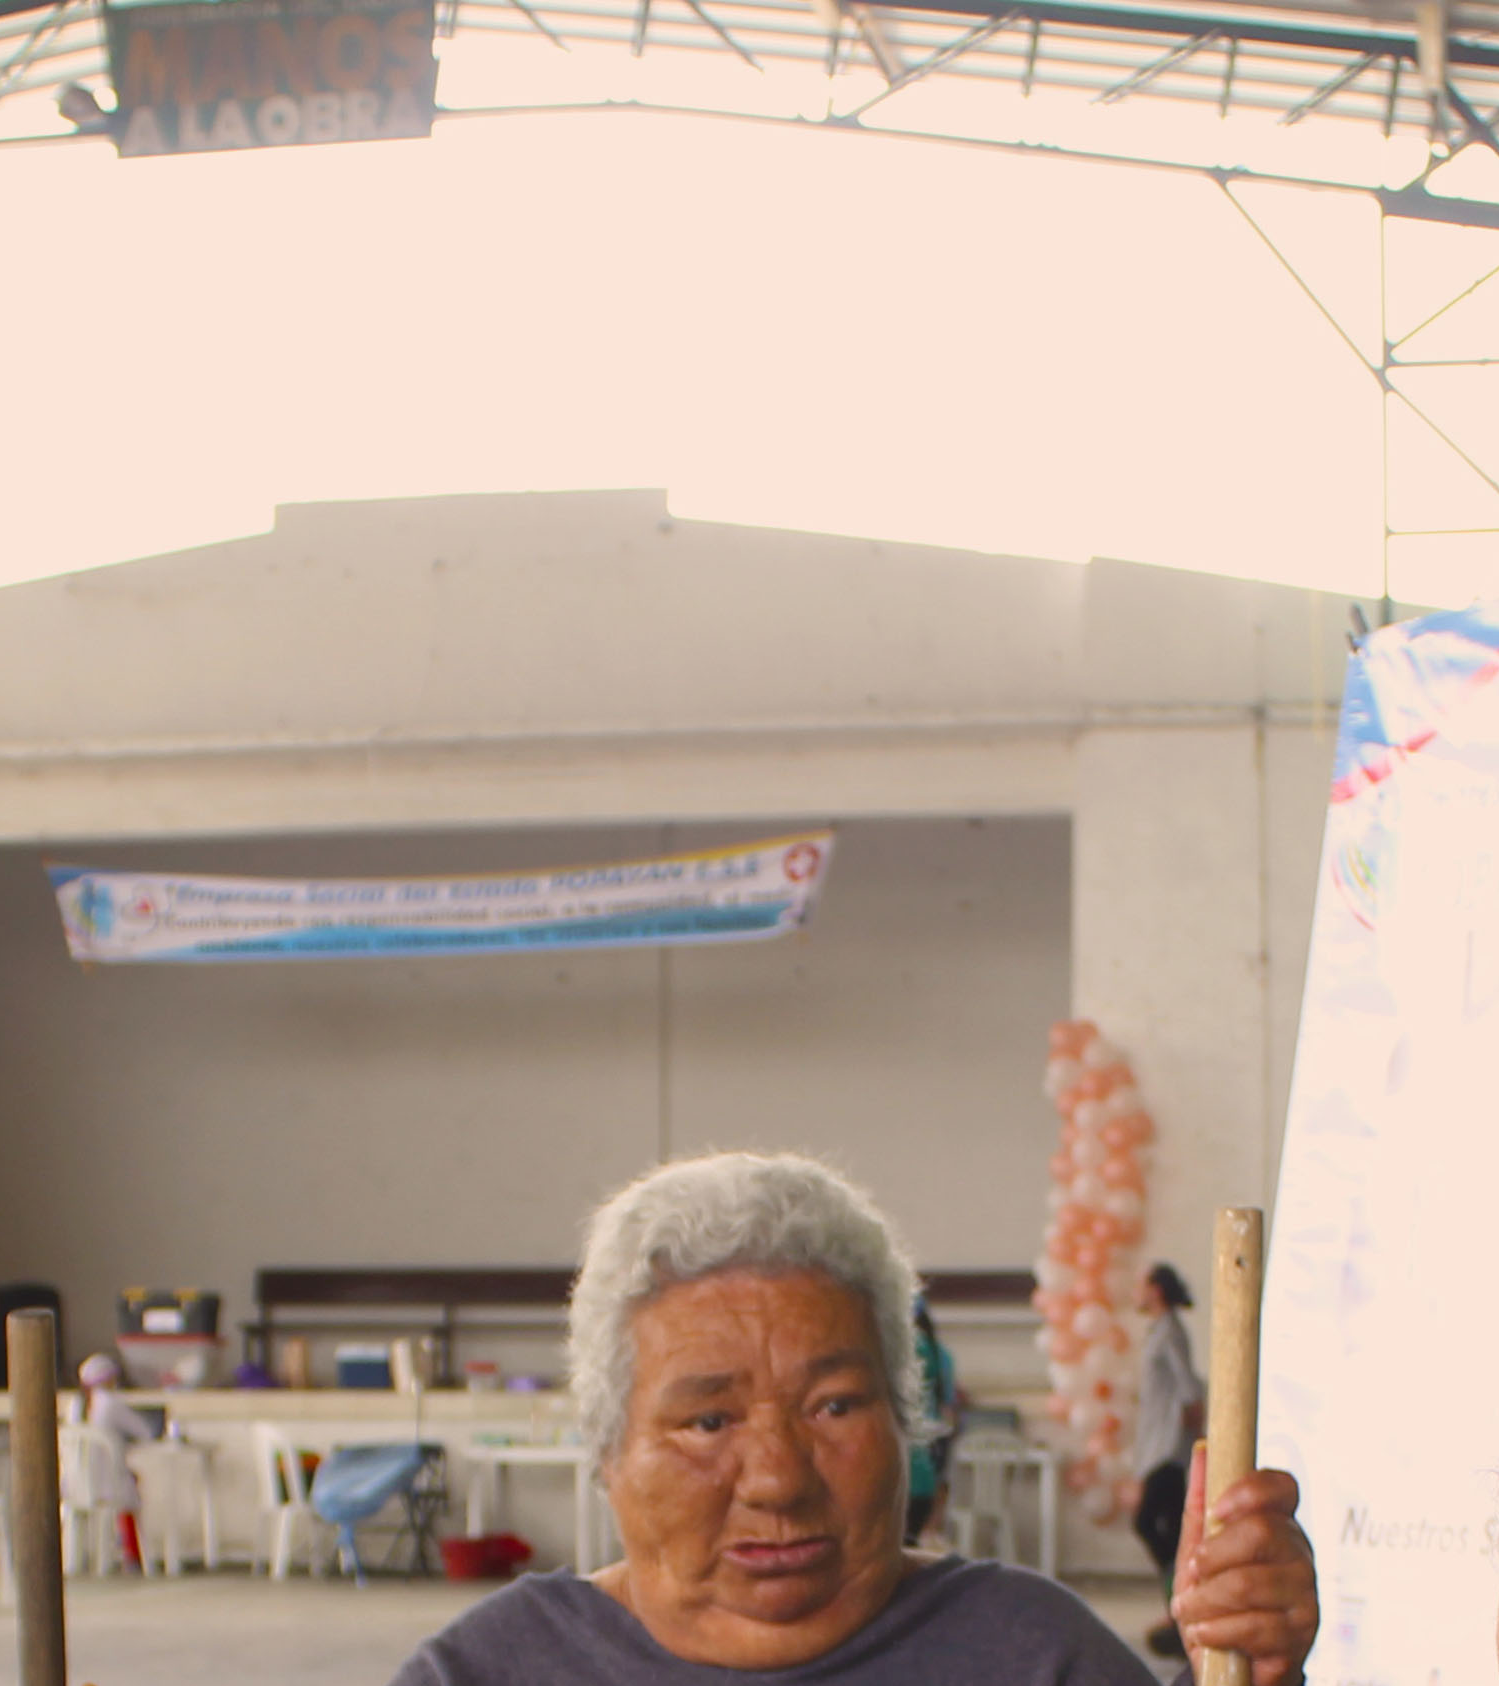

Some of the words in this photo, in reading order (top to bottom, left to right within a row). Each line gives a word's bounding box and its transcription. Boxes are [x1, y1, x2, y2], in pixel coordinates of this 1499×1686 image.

[125, 9, 427, 107] MANOS
[123, 105, 167, 155] A
[179, 98, 252, 149] LA
[255, 90, 421, 145] OBRA
[1341, 1507, 1467, 1553] Nuestros
